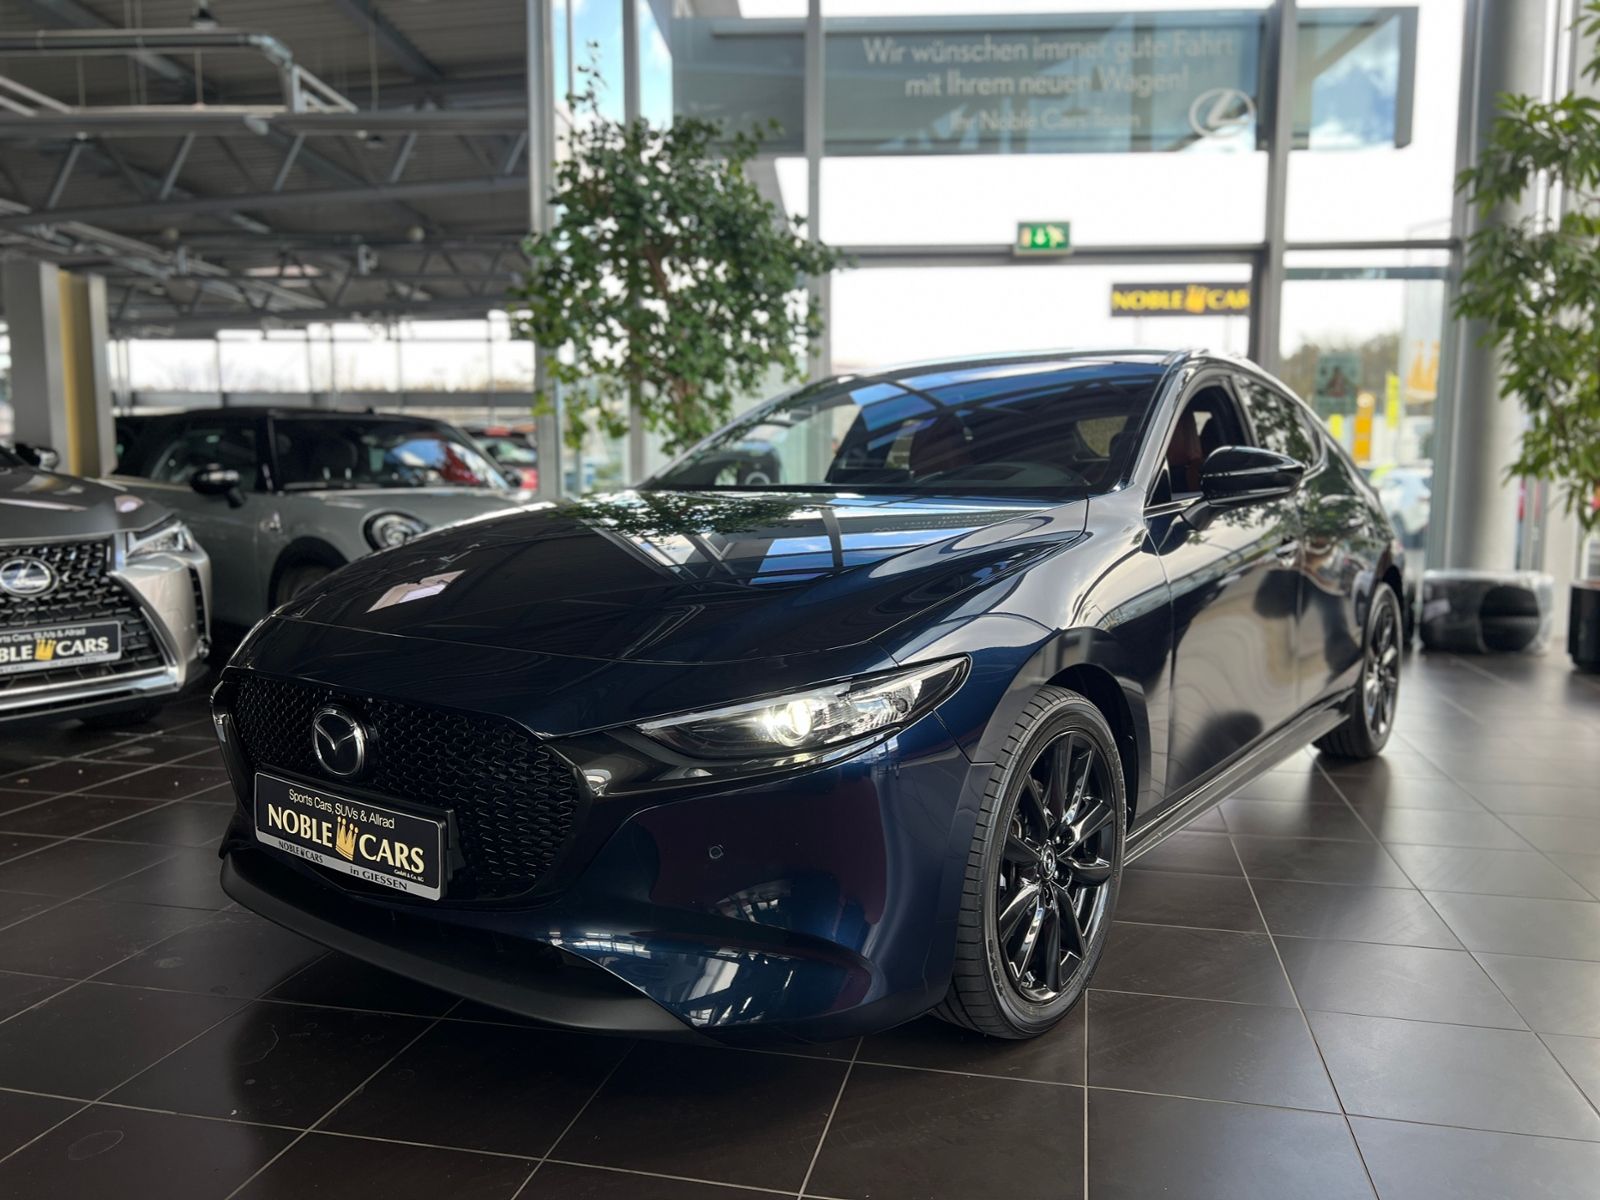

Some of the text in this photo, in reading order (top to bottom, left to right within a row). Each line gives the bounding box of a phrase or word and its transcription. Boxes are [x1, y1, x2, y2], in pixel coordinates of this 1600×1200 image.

[862, 30, 1234, 65] Wir wünschen immer gute Fahrt
[905, 72, 942, 96] mit
[947, 69, 1015, 96] Ihrem
[1019, 73, 1091, 95] neuen
[1112, 288, 1250, 311] NOBLE CAR
[0, 645, 33, 662] BLE
[56, 637, 109, 656] CARS
[289, 788, 395, 829] Sports Cars, SUVs & Allrad
[268, 803, 425, 874] NOBLE CARS
[278, 840, 324, 864] NOBLE CARS
[350, 866, 408, 890] in GIESSEN
